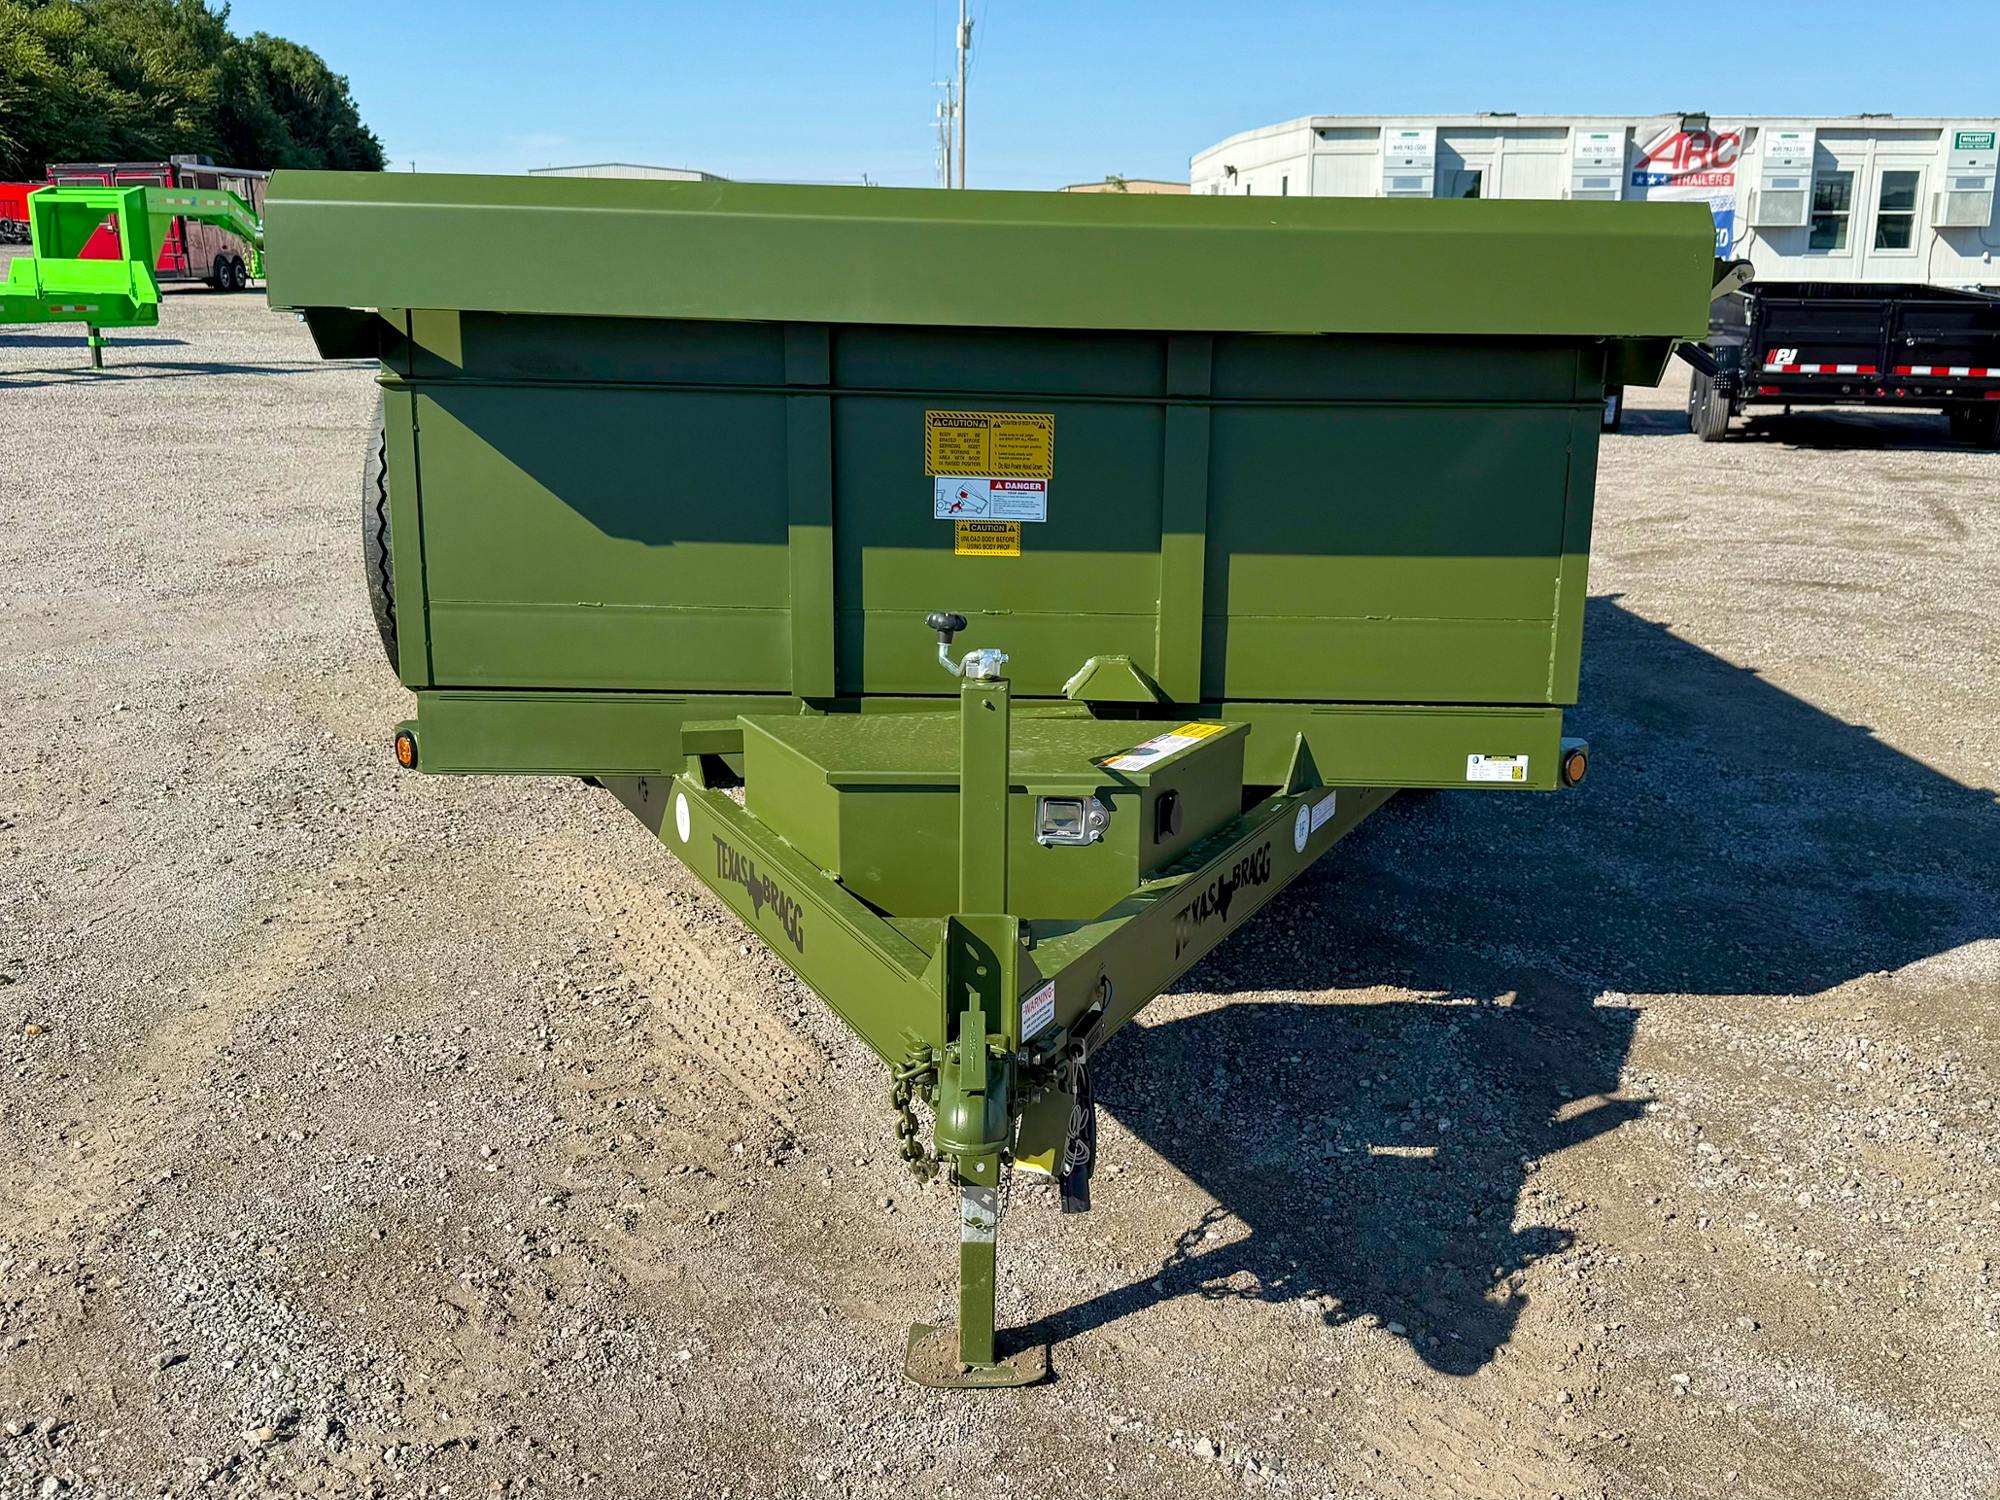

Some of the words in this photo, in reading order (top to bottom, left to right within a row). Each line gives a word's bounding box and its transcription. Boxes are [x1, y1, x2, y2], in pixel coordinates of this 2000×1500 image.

[1635, 131, 1740, 170] ARC
[1676, 174, 1731, 186] TRAILERS
[1775, 348, 1798, 365] PJ
[941, 418, 980, 428] CAUTION
[1004, 482, 1042, 490] DANGER
[970, 524, 1005, 532] CAUTION
[995, 536, 1015, 544] BEFORE
[712, 833, 749, 888] TEXAS
[762, 873, 804, 954] BRAGG
[1171, 881, 1217, 960] TEXAS
[1232, 840, 1271, 892] BRAGG
